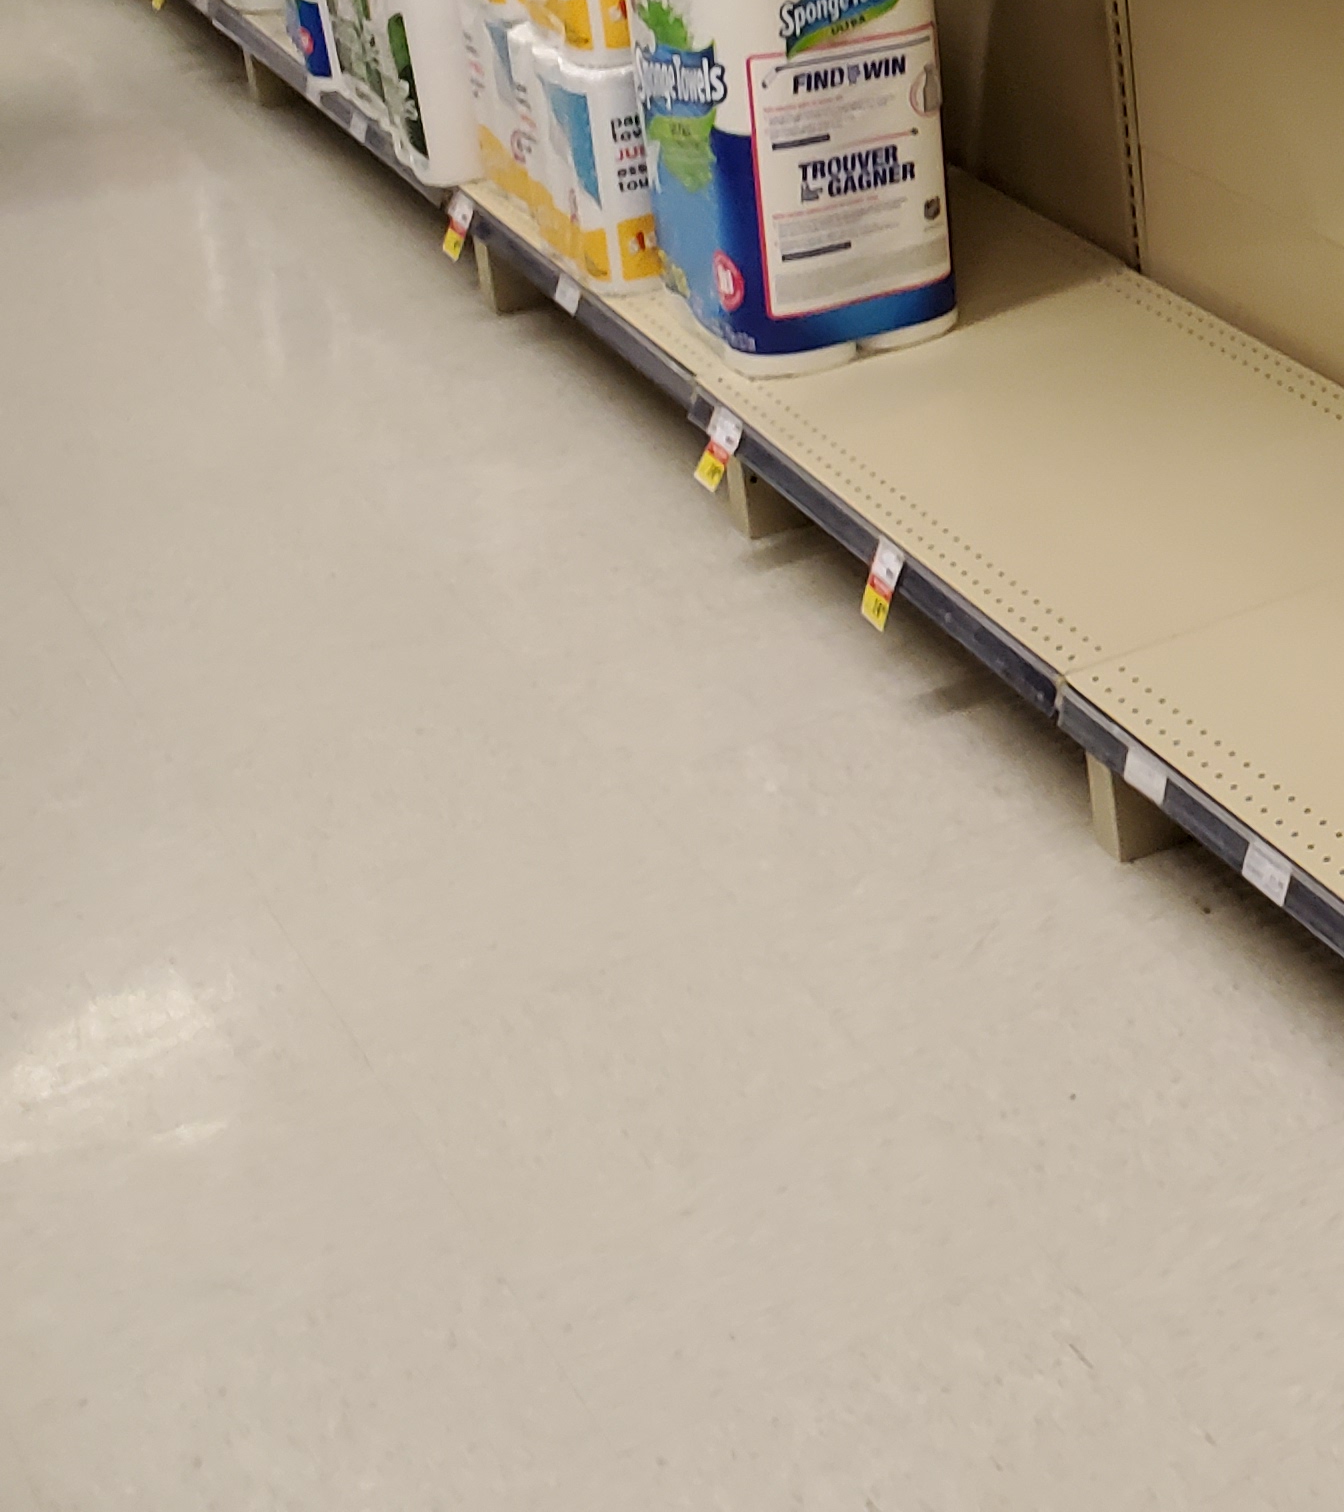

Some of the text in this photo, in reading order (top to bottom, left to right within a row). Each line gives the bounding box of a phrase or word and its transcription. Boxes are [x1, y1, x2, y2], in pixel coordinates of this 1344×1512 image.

[792, 53, 907, 96] FIND WIN
[798, 143, 899, 183] TROUVER
[826, 160, 916, 199] GAGNER
